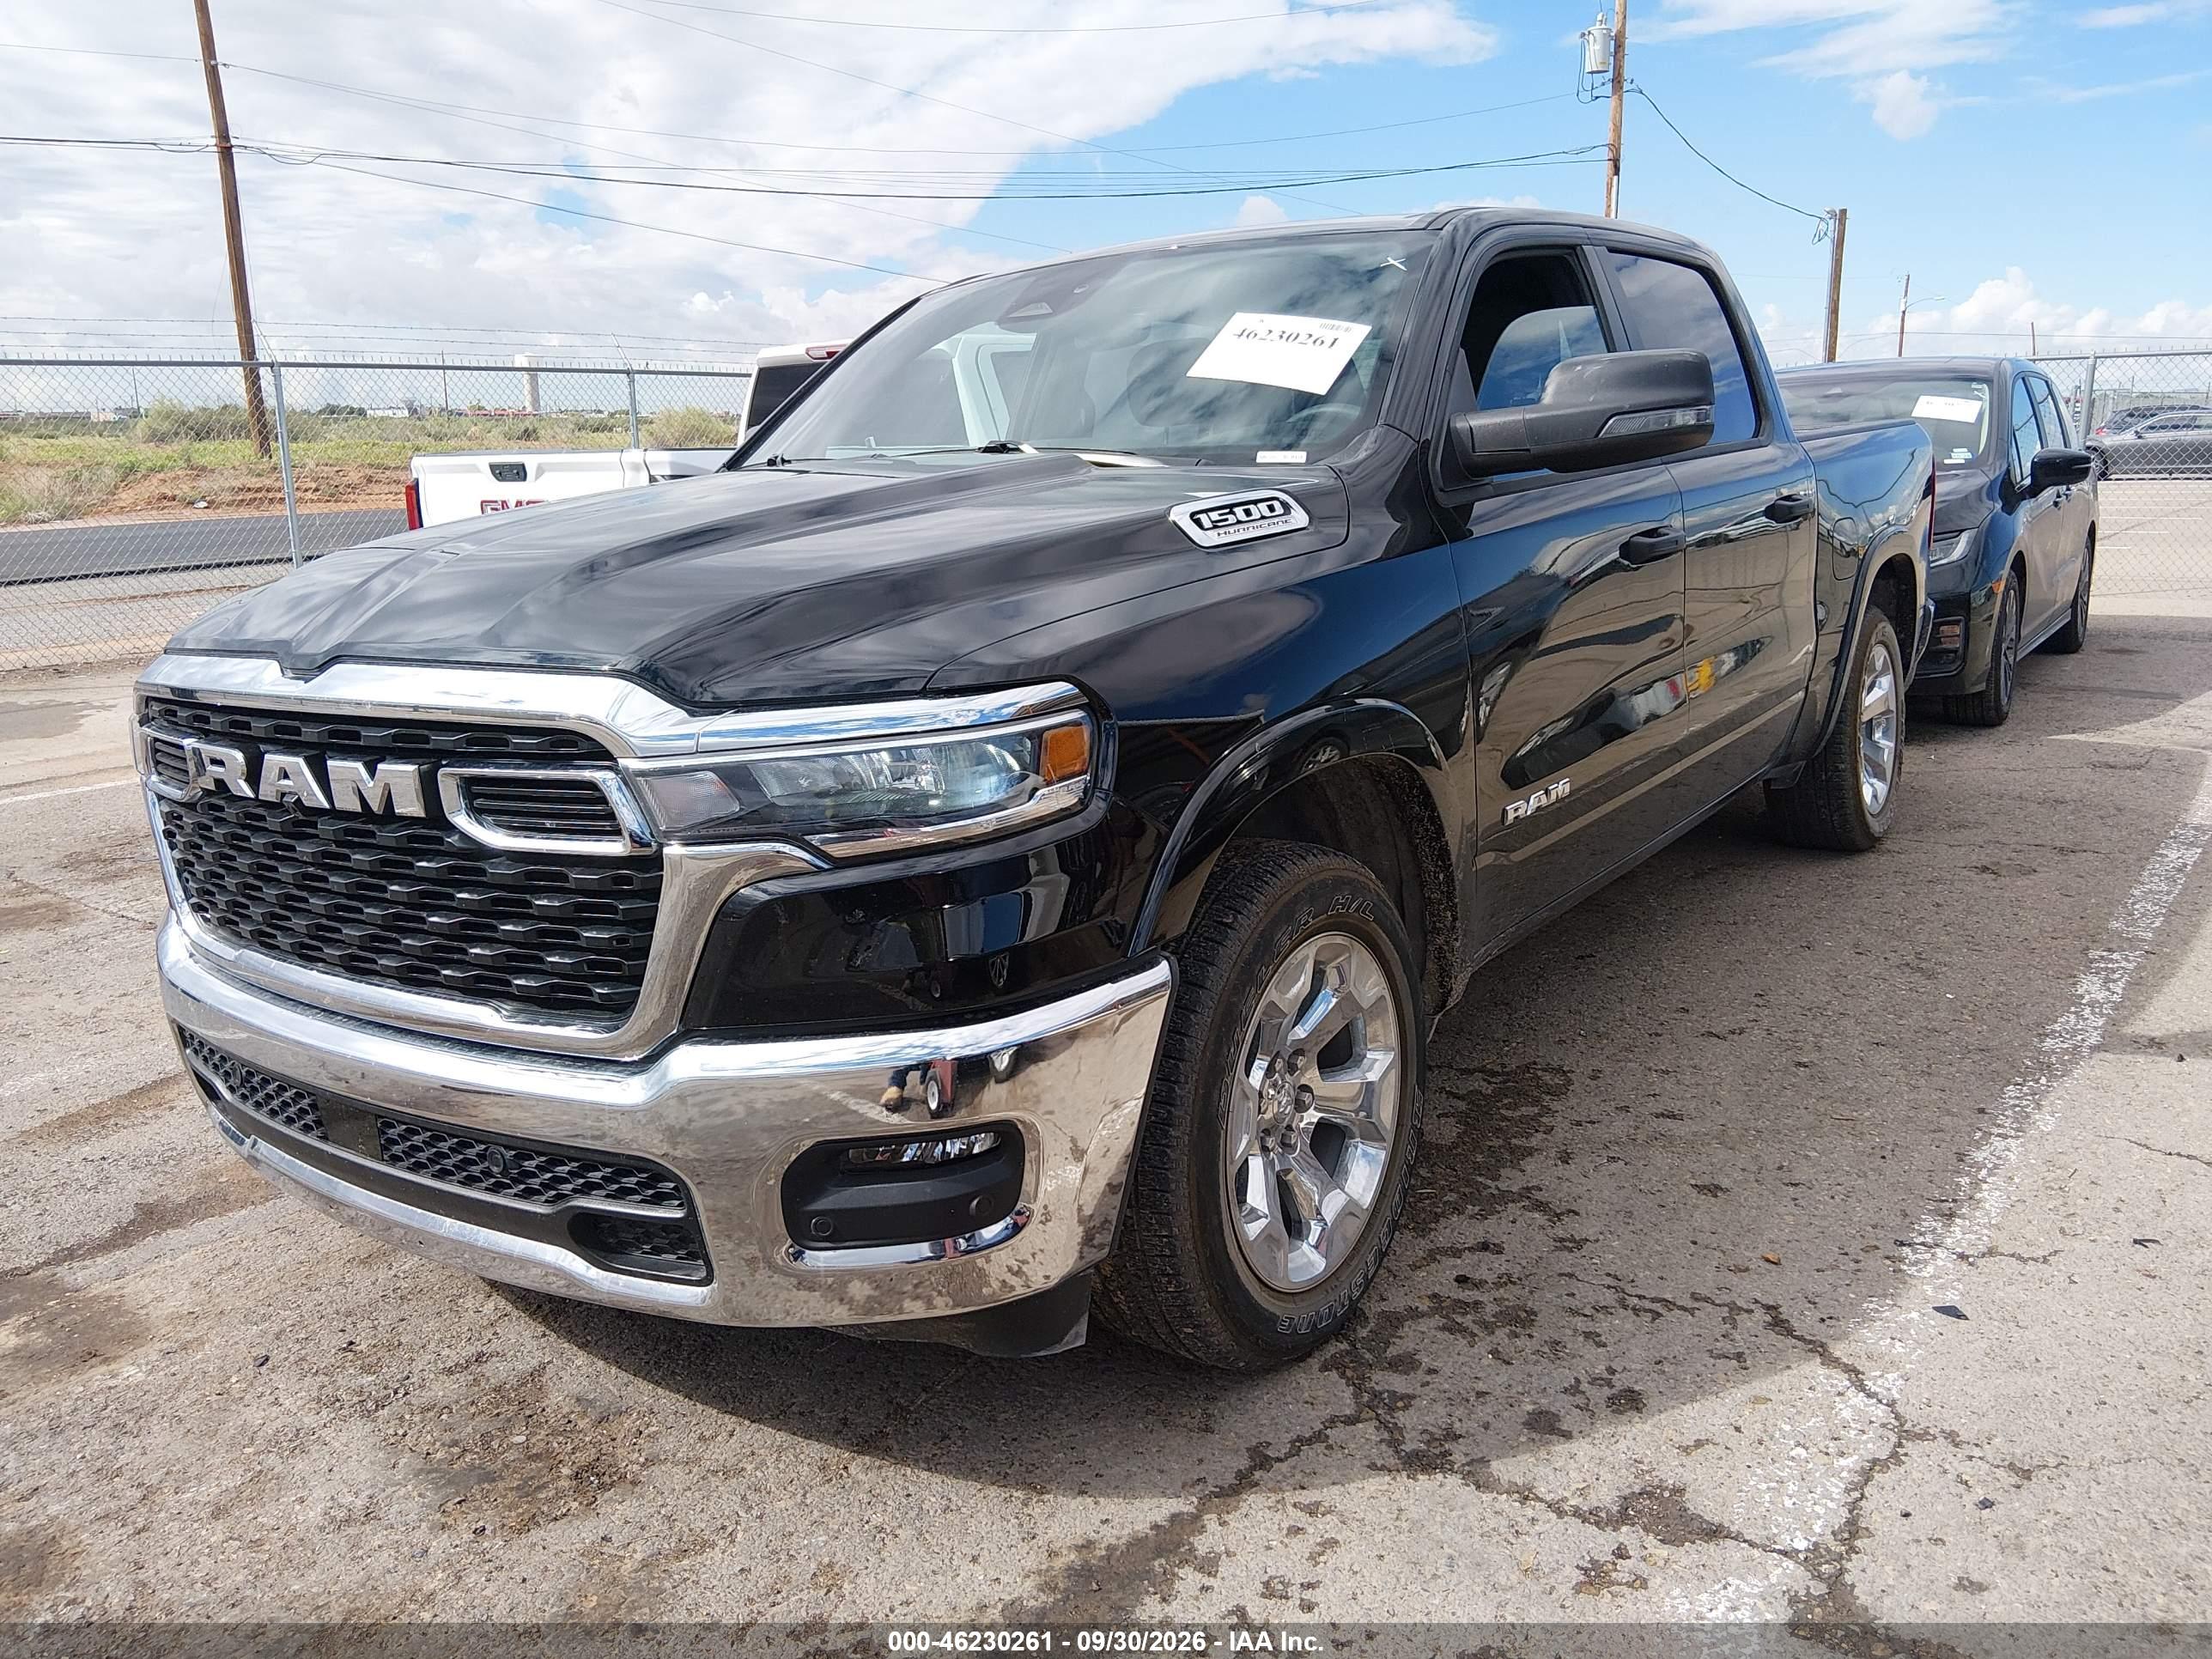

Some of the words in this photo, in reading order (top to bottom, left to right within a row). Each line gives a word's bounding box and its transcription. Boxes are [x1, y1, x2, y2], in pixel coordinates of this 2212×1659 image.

[1233, 327, 1340, 349] 46230261
[480, 499, 548, 515] GM
[1193, 500, 1285, 530] 1500
[192, 740, 428, 819] RAM
[1502, 777, 1571, 826] RAM
